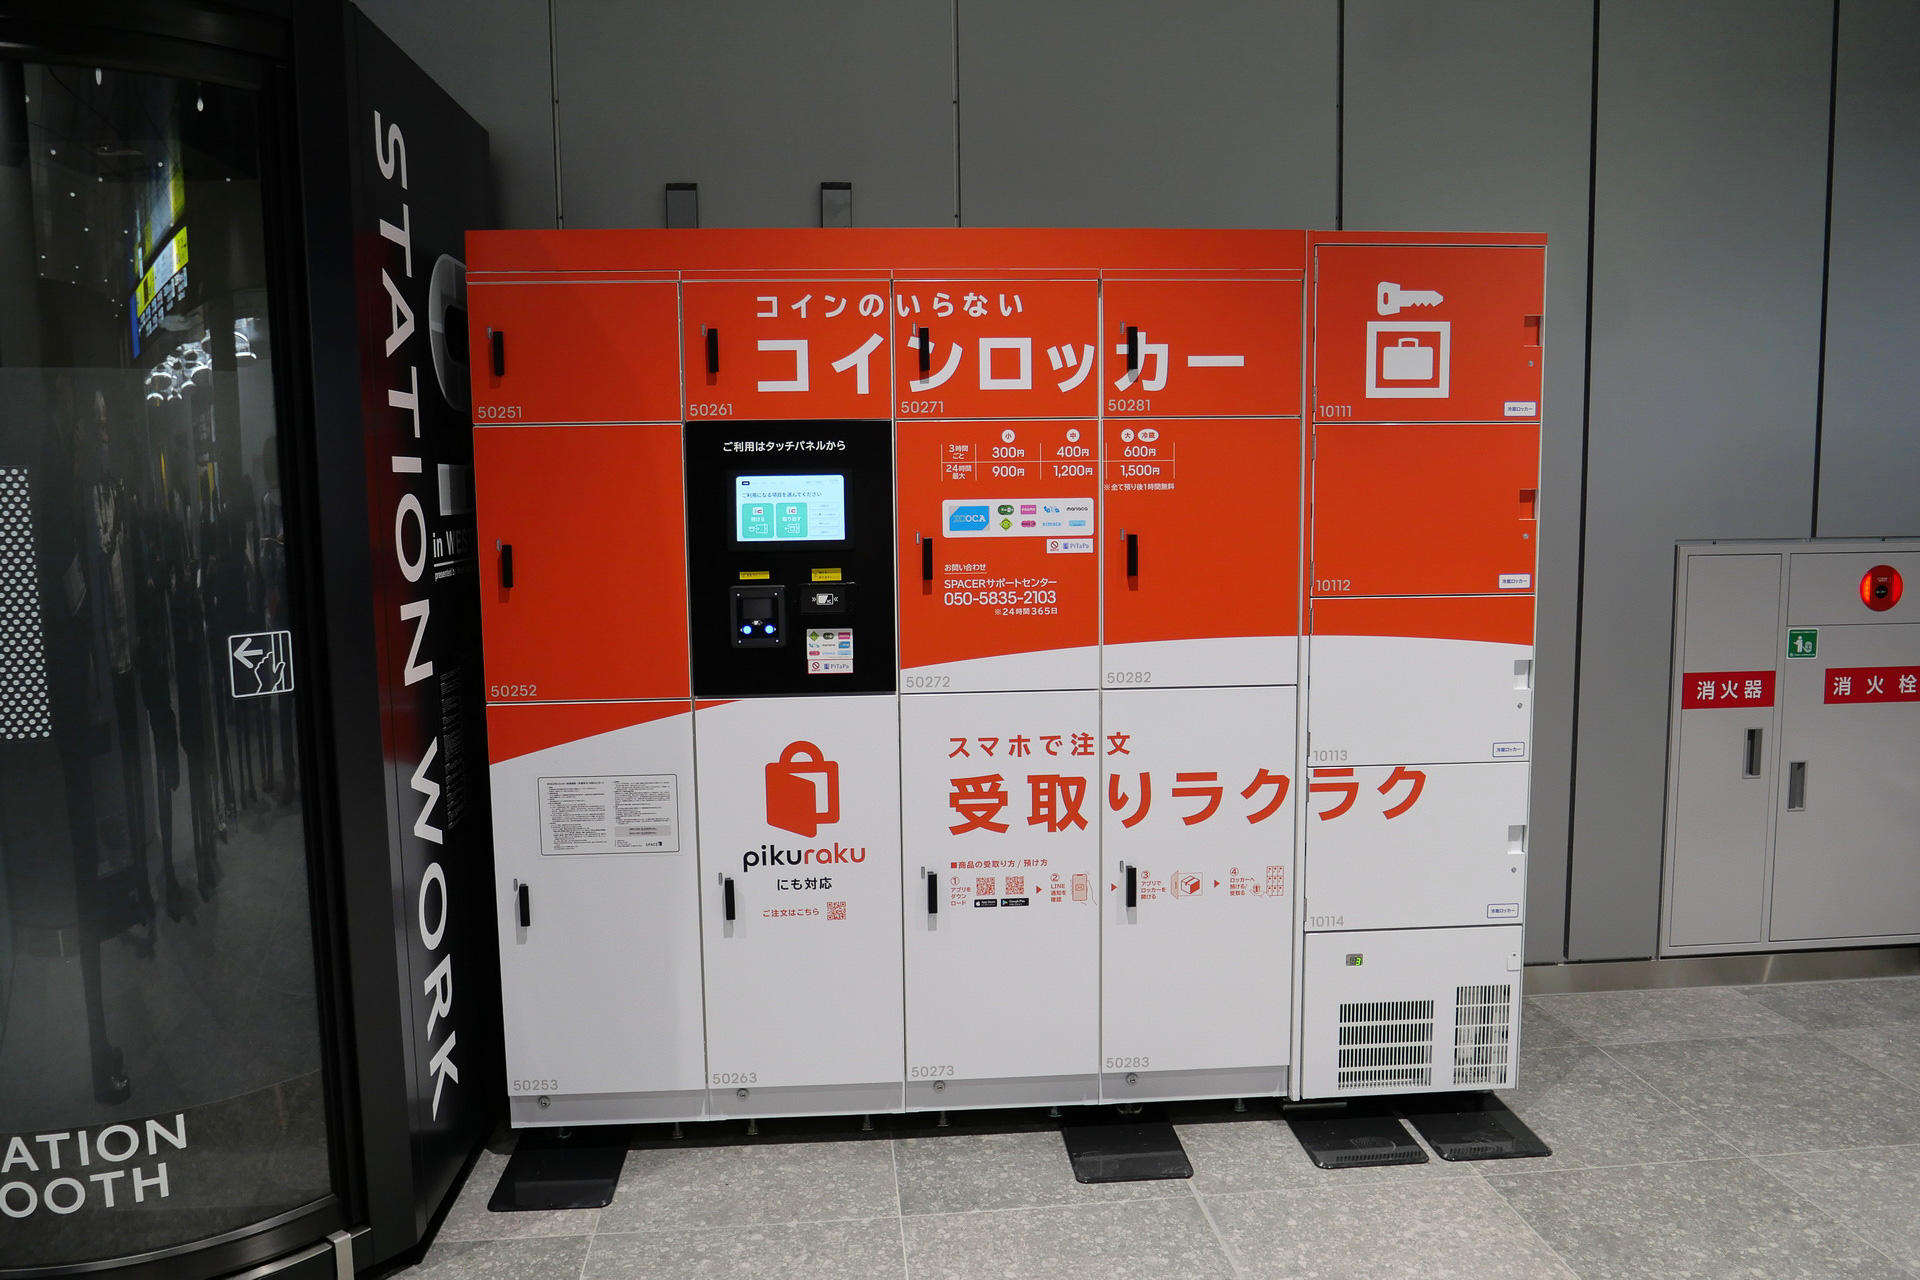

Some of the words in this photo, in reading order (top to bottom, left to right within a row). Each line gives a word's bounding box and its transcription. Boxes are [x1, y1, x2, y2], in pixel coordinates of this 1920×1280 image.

[756, 292, 1022, 318] コインのいらない
[757, 331, 1244, 395] コインロッカー
[689, 403, 733, 417] 50261
[900, 400, 944, 414] 50271
[1107, 398, 1151, 412] 50281
[1319, 404, 1352, 418] 10111
[478, 406, 522, 419] 50251
[1005, 432, 1012, 440] 小
[1070, 432, 1076, 440] 中
[1124, 432, 1132, 440] 大
[1140, 432, 1156, 440] 冷蔵
[722, 440, 846, 452] ご利用はタッチパネルから
[948, 444, 968, 452] 3時間
[992, 446, 1025, 458] 300円
[1056, 446, 1090, 458] 400円
[1124, 445, 1156, 458] 600円
[952, 452, 964, 460] ごと
[946, 464, 972, 473] 24時間
[992, 466, 1025, 478] 900円
[1053, 464, 1093, 478] 1,200円
[1120, 464, 1160, 476] 1,500円
[952, 472, 966, 480] 最大
[953, 514, 986, 523] ICOCA
[432, 532, 444, 558] in
[944, 563, 987, 572] お問い合わせ
[944, 578, 1057, 590] SPACERサポートセンター
[1316, 579, 1350, 592] 10112
[944, 590, 1057, 606] 050-5835-2103
[374, 110, 435, 686] STATION
[409, 737, 459, 1122] WORK
[994, 607, 1058, 616] ※24時間365日
[906, 676, 950, 688] 50272
[1106, 672, 1152, 684] 50282
[490, 684, 538, 698] 50252
[1696, 680, 1762, 700] 消火器
[1832, 674, 1918, 696] 消火栓
[948, 732, 1131, 758] スマホで注文
[1313, 750, 1348, 762] 10113
[948, 766, 1427, 836] 受取りラクラク
[743, 842, 866, 872] pikuraku
[958, 860, 1016, 870] 商品の受取り方
[1024, 858, 1048, 868] 預け方
[777, 877, 832, 891] にも対応
[762, 908, 820, 918] ご注文はこちら
[1310, 916, 1344, 928] 10114
[1106, 1056, 1150, 1069] 50283
[912, 1065, 954, 1078] 50273
[712, 1072, 758, 1084] 50263
[513, 1079, 558, 1092] 50253
